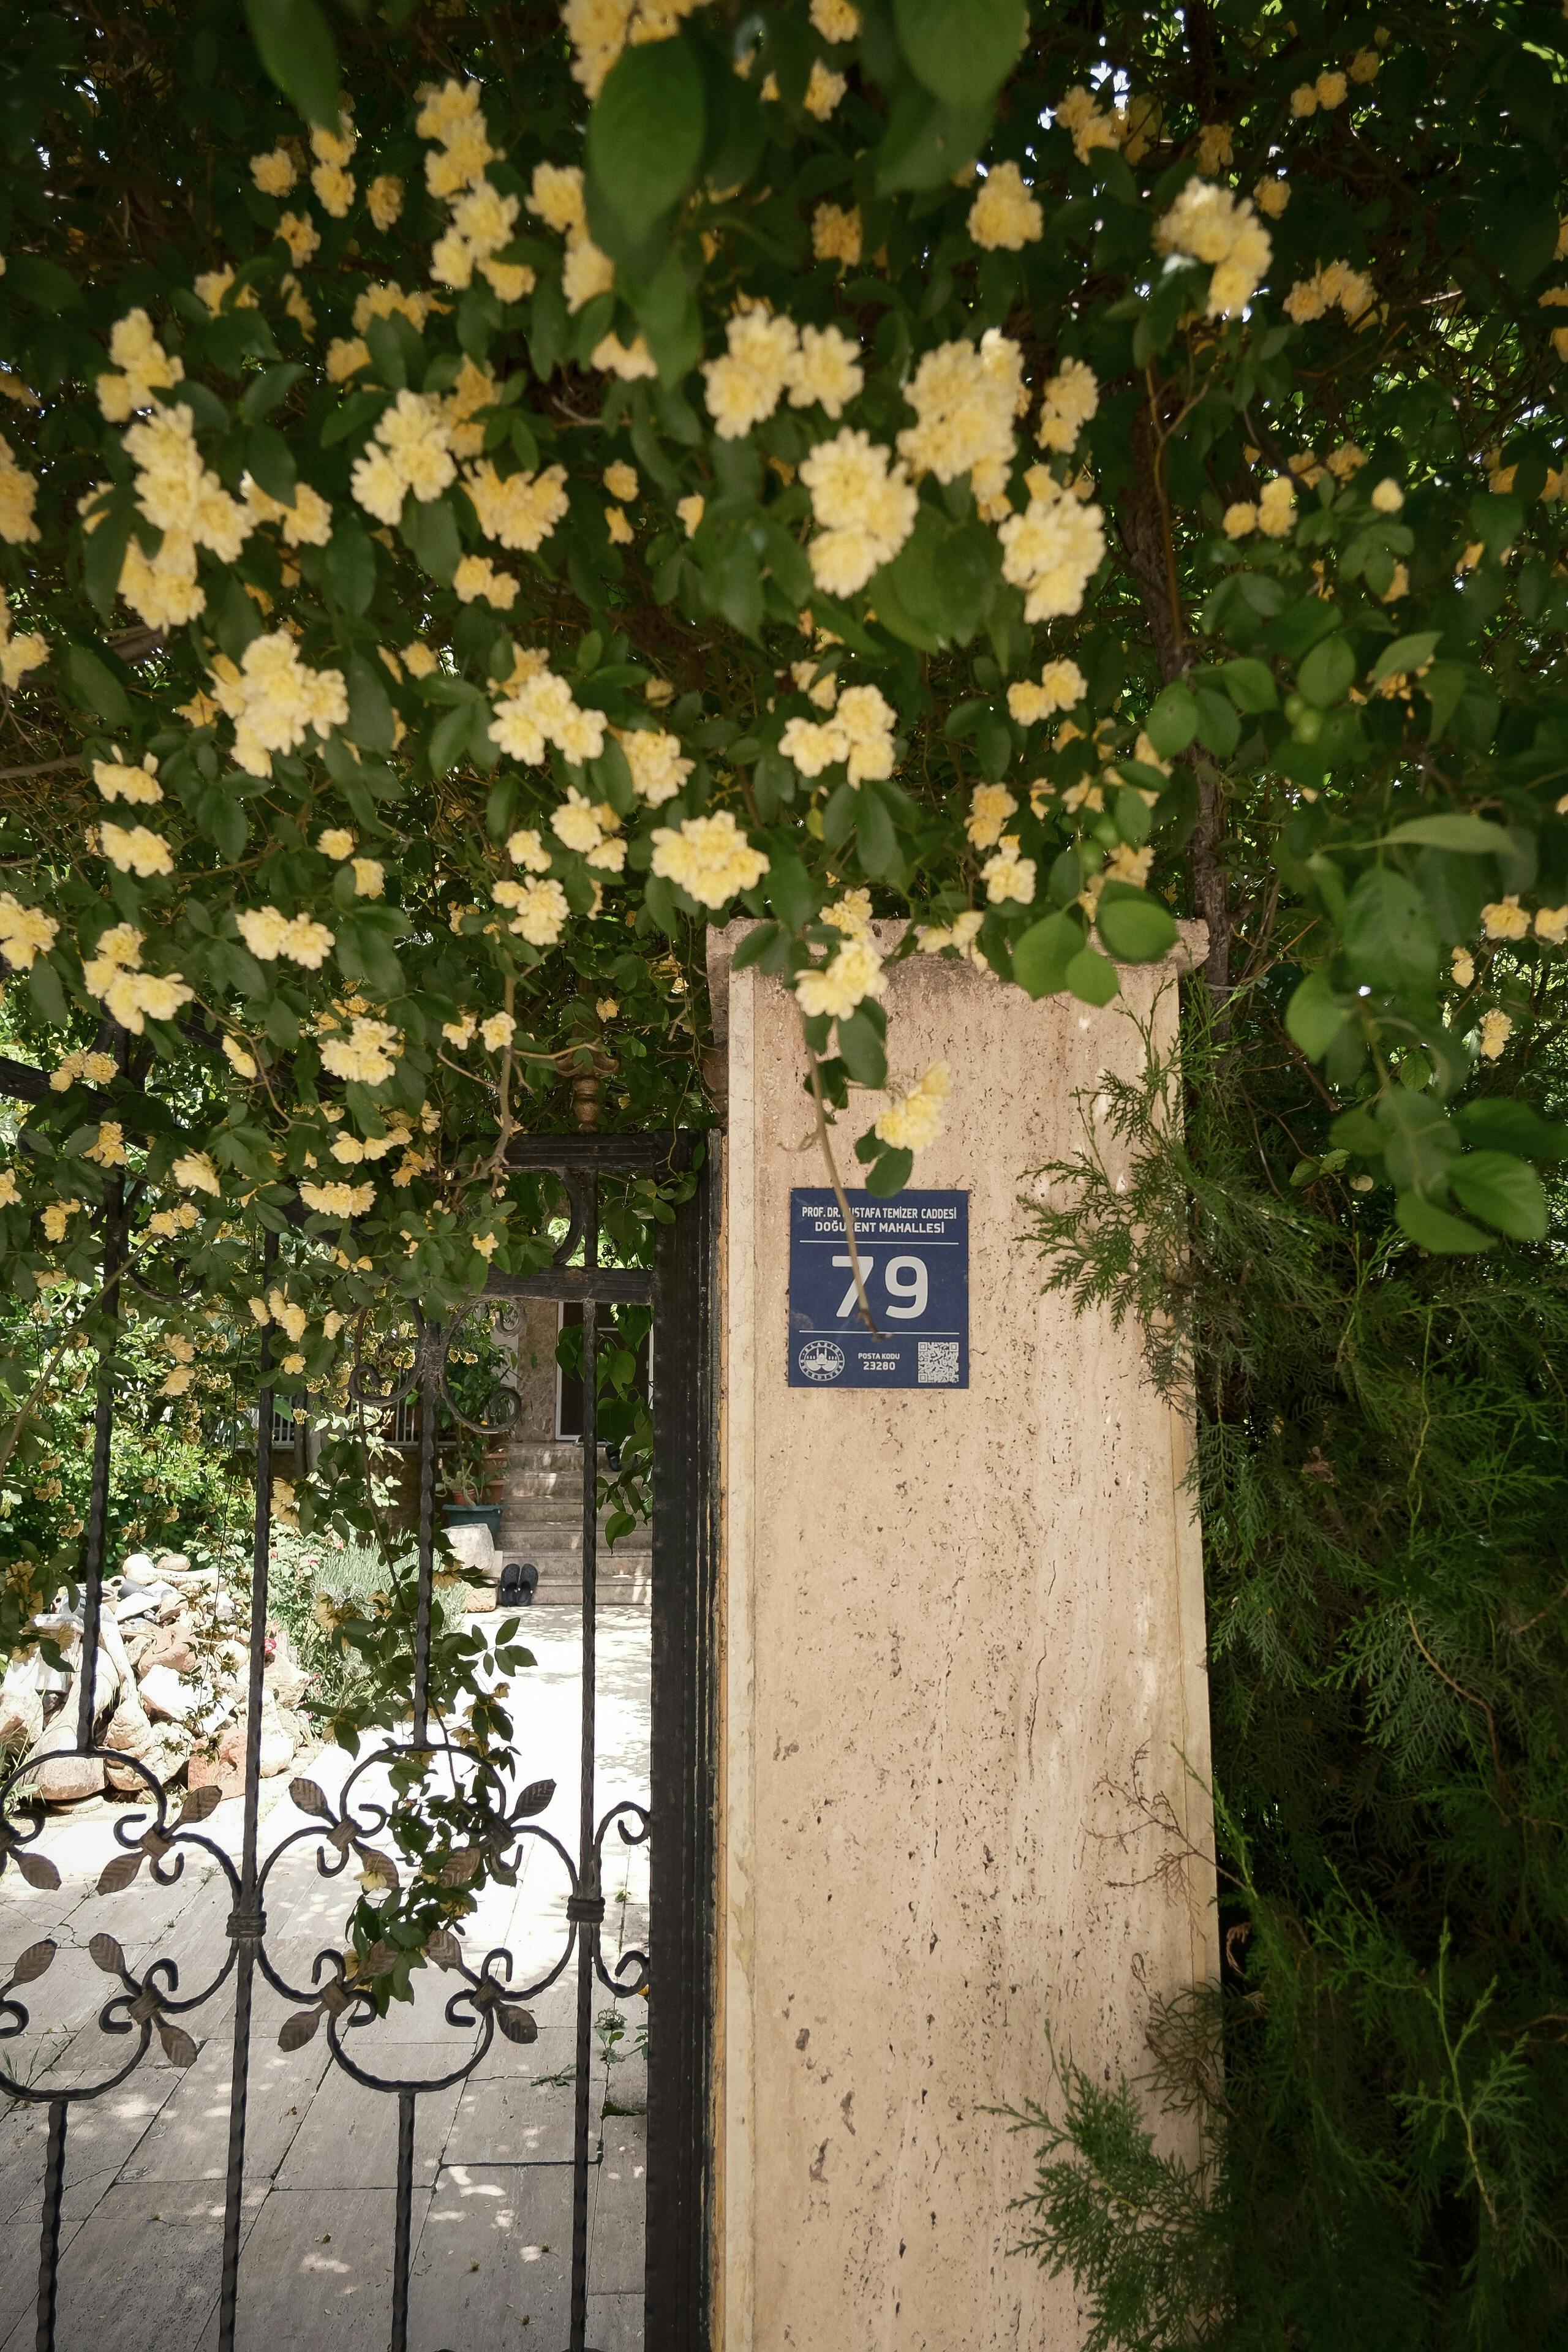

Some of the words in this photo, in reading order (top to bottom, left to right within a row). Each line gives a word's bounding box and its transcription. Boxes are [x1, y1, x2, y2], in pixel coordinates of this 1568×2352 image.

[802, 1207, 826, 1218] PROF.
[827, 1207, 841, 1218] DR.
[843, 1207, 881, 1218] USTAFA
[882, 1206, 918, 1219] TEMİZER
[921, 1207, 957, 1219] CADDESİ
[815, 1219, 876, 1232] DOĞUENT
[879, 1221, 944, 1234] MAHALLESİ
[832, 1256, 928, 1319] 79
[863, 1361, 895, 1370] 23280
